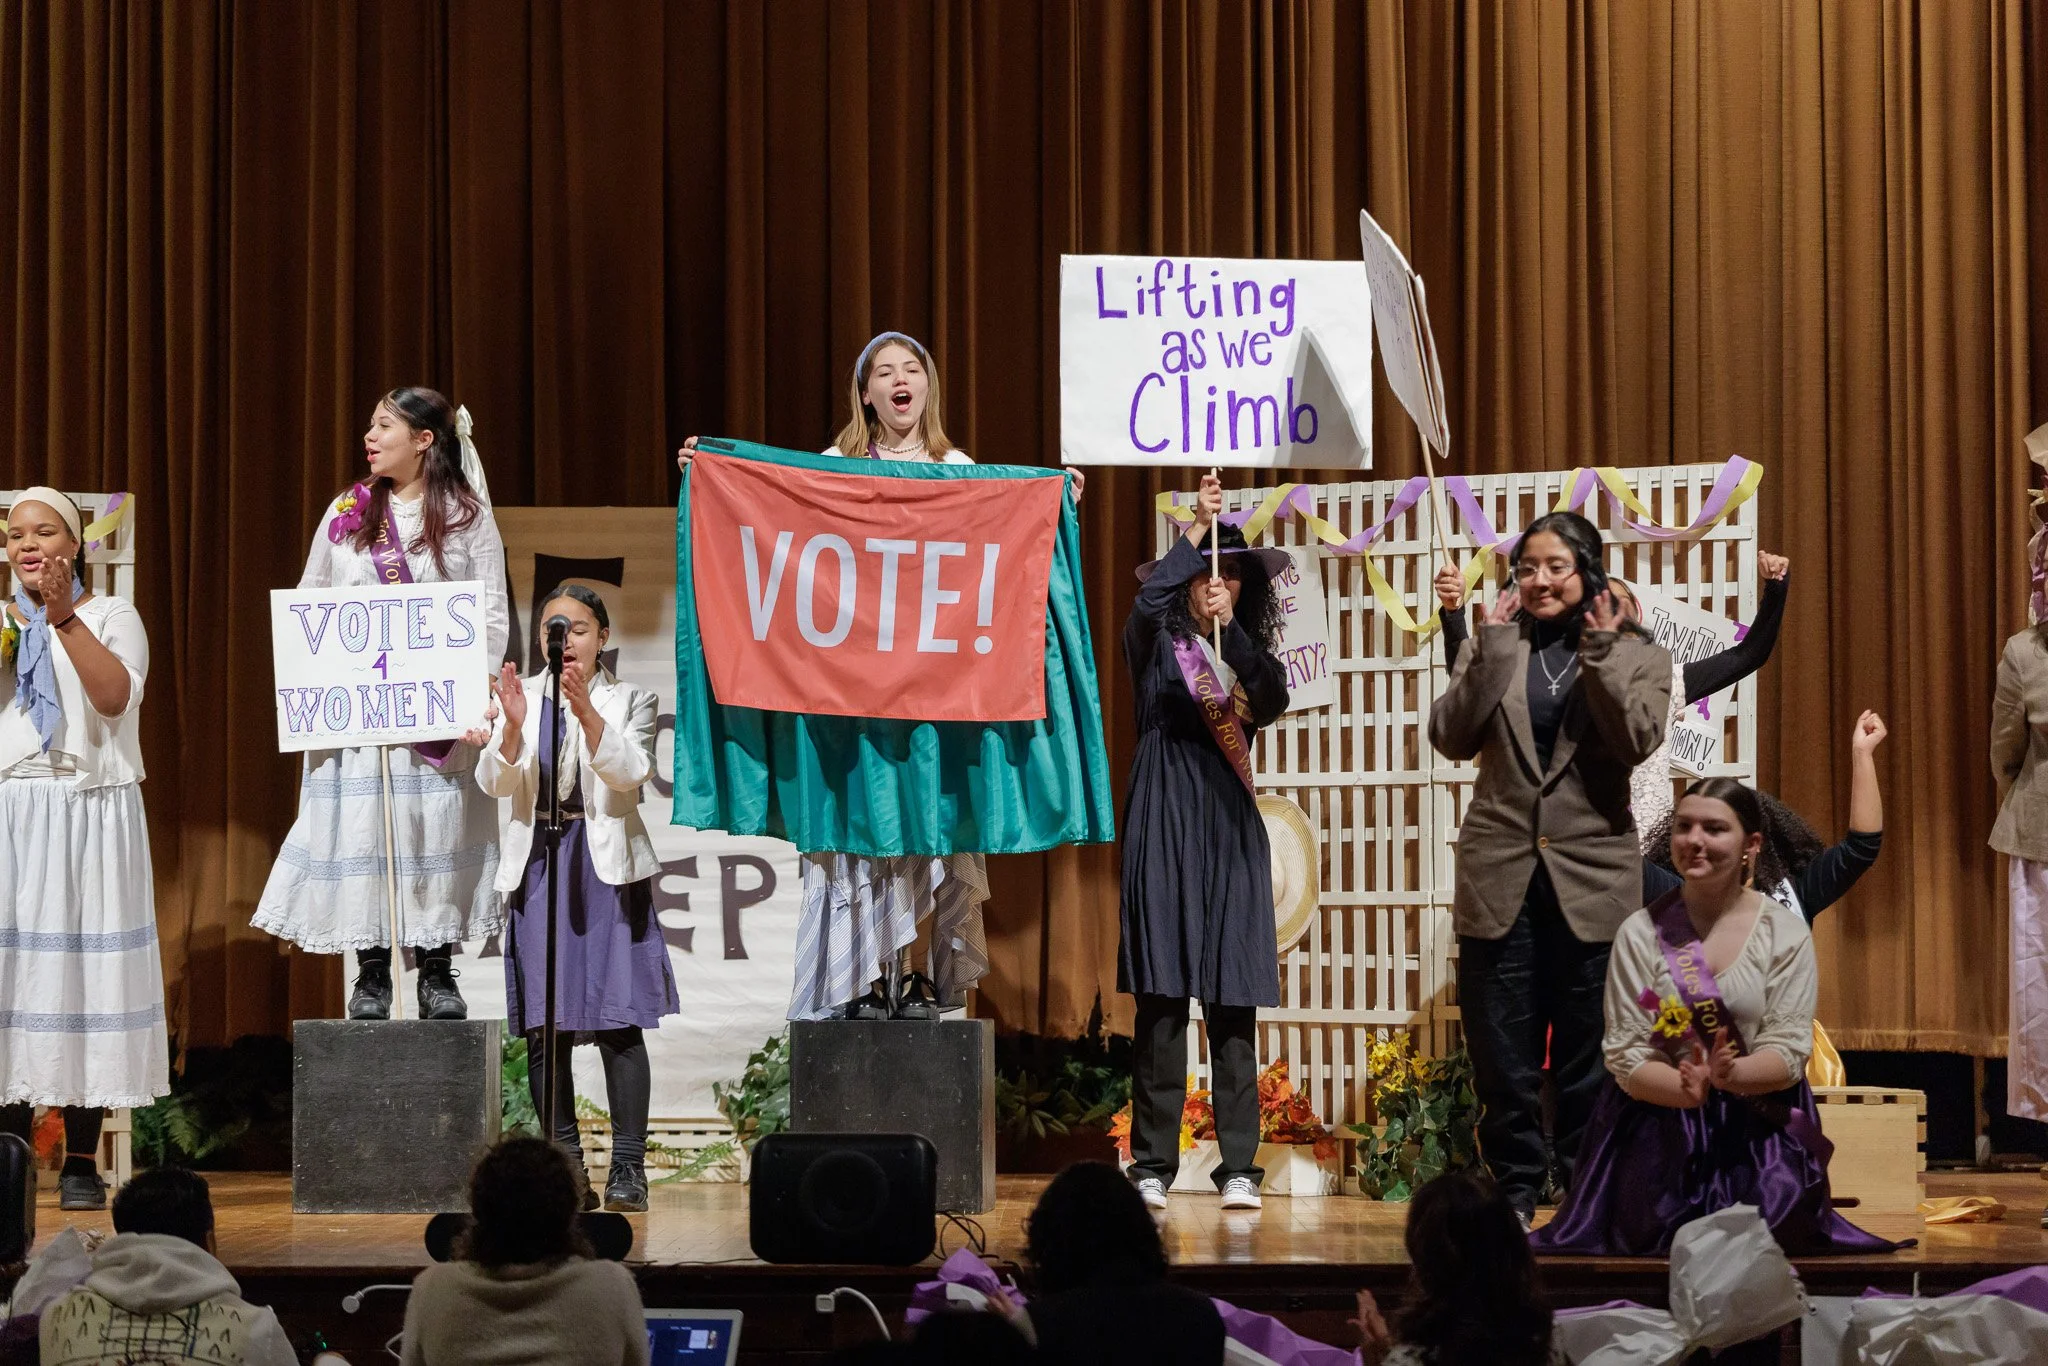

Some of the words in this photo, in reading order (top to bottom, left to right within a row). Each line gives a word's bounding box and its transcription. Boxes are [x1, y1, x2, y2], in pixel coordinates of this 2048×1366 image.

[1096, 259, 1296, 337] Lifting
[1161, 328, 1207, 374] as
[1217, 329, 1273, 369] we
[1130, 372, 1319, 453] Climb
[289, 593, 477, 655] VOTES
[739, 525, 1001, 655] VOTE!
[371, 651, 388, 681] 4
[278, 680, 456, 733] WOMEN
[1192, 671, 1223, 721] Votes
[1215, 721, 1242, 752] For
